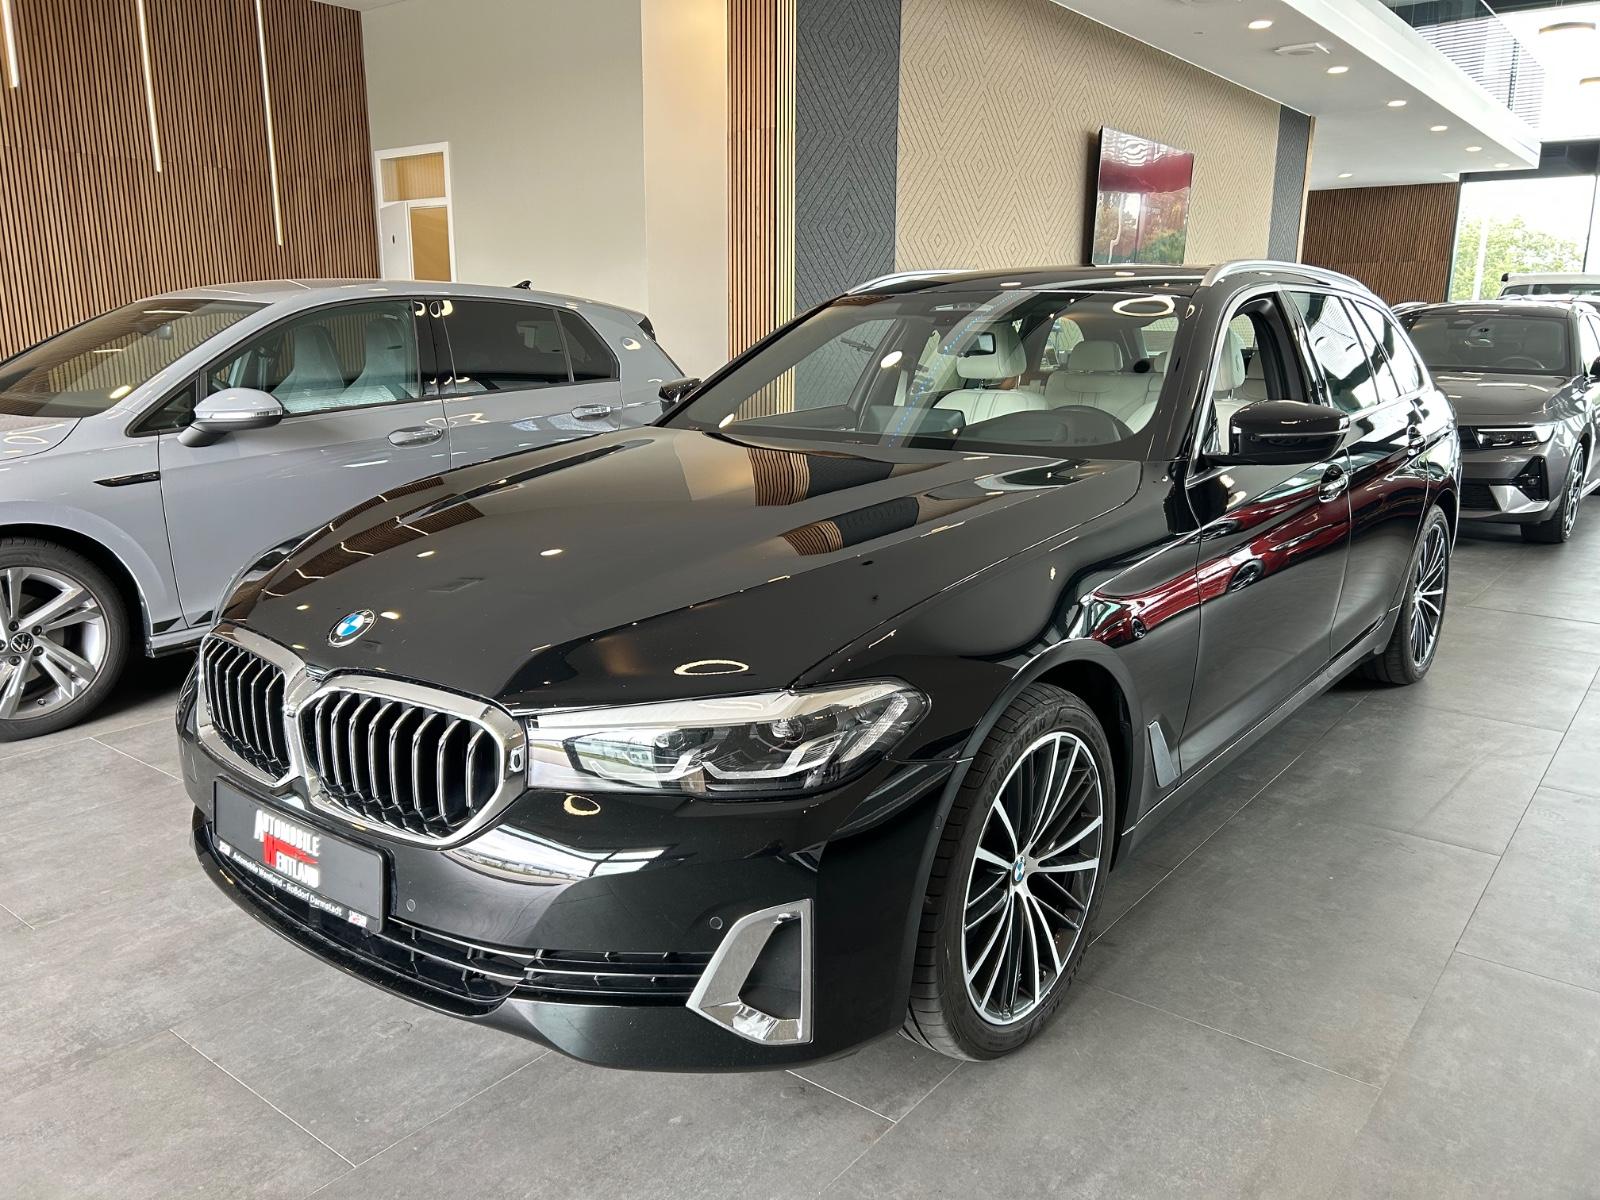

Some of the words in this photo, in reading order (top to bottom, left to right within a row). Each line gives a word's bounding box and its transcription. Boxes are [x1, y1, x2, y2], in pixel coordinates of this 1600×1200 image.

[254, 810, 320, 857] AUTOMOBILE
[263, 831, 320, 888] WEITLAND
[309, 894, 342, 917] Darmstadt
